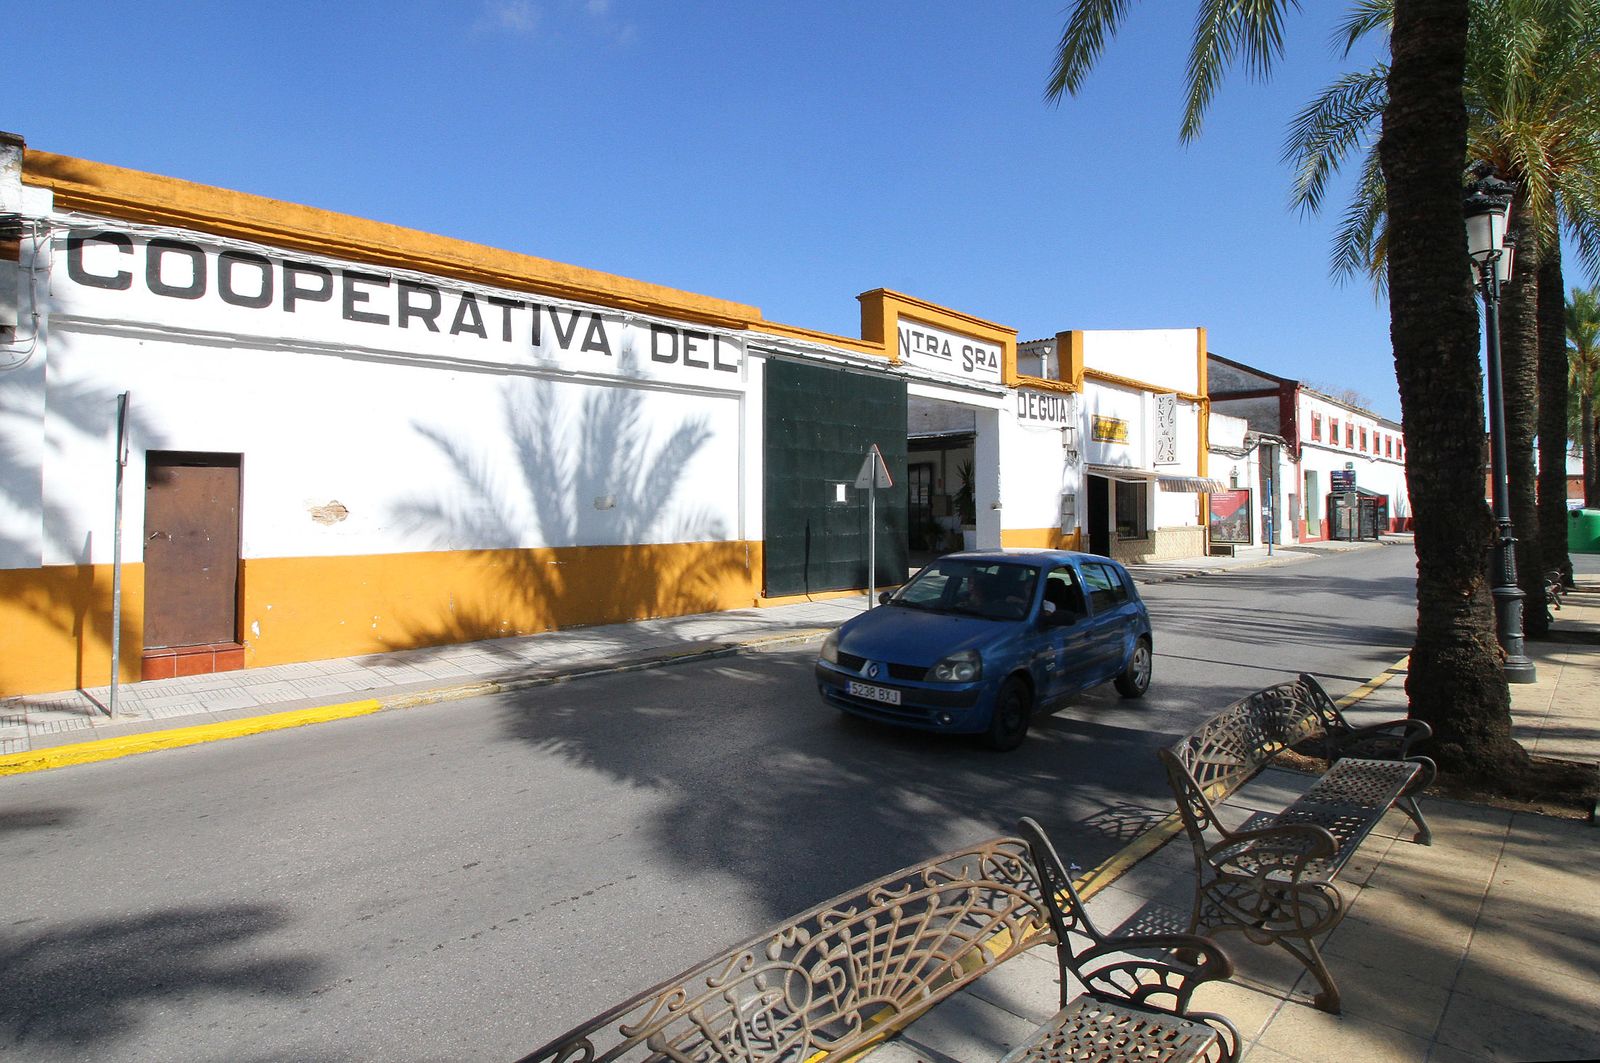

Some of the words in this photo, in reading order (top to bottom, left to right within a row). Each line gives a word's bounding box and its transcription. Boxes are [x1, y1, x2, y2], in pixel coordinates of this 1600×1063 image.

[67, 229, 613, 356] COOPERATIVA
[650, 322, 738, 373] DEL
[852, 683, 876, 698] 5238
[879, 688, 898, 703] BXJ
